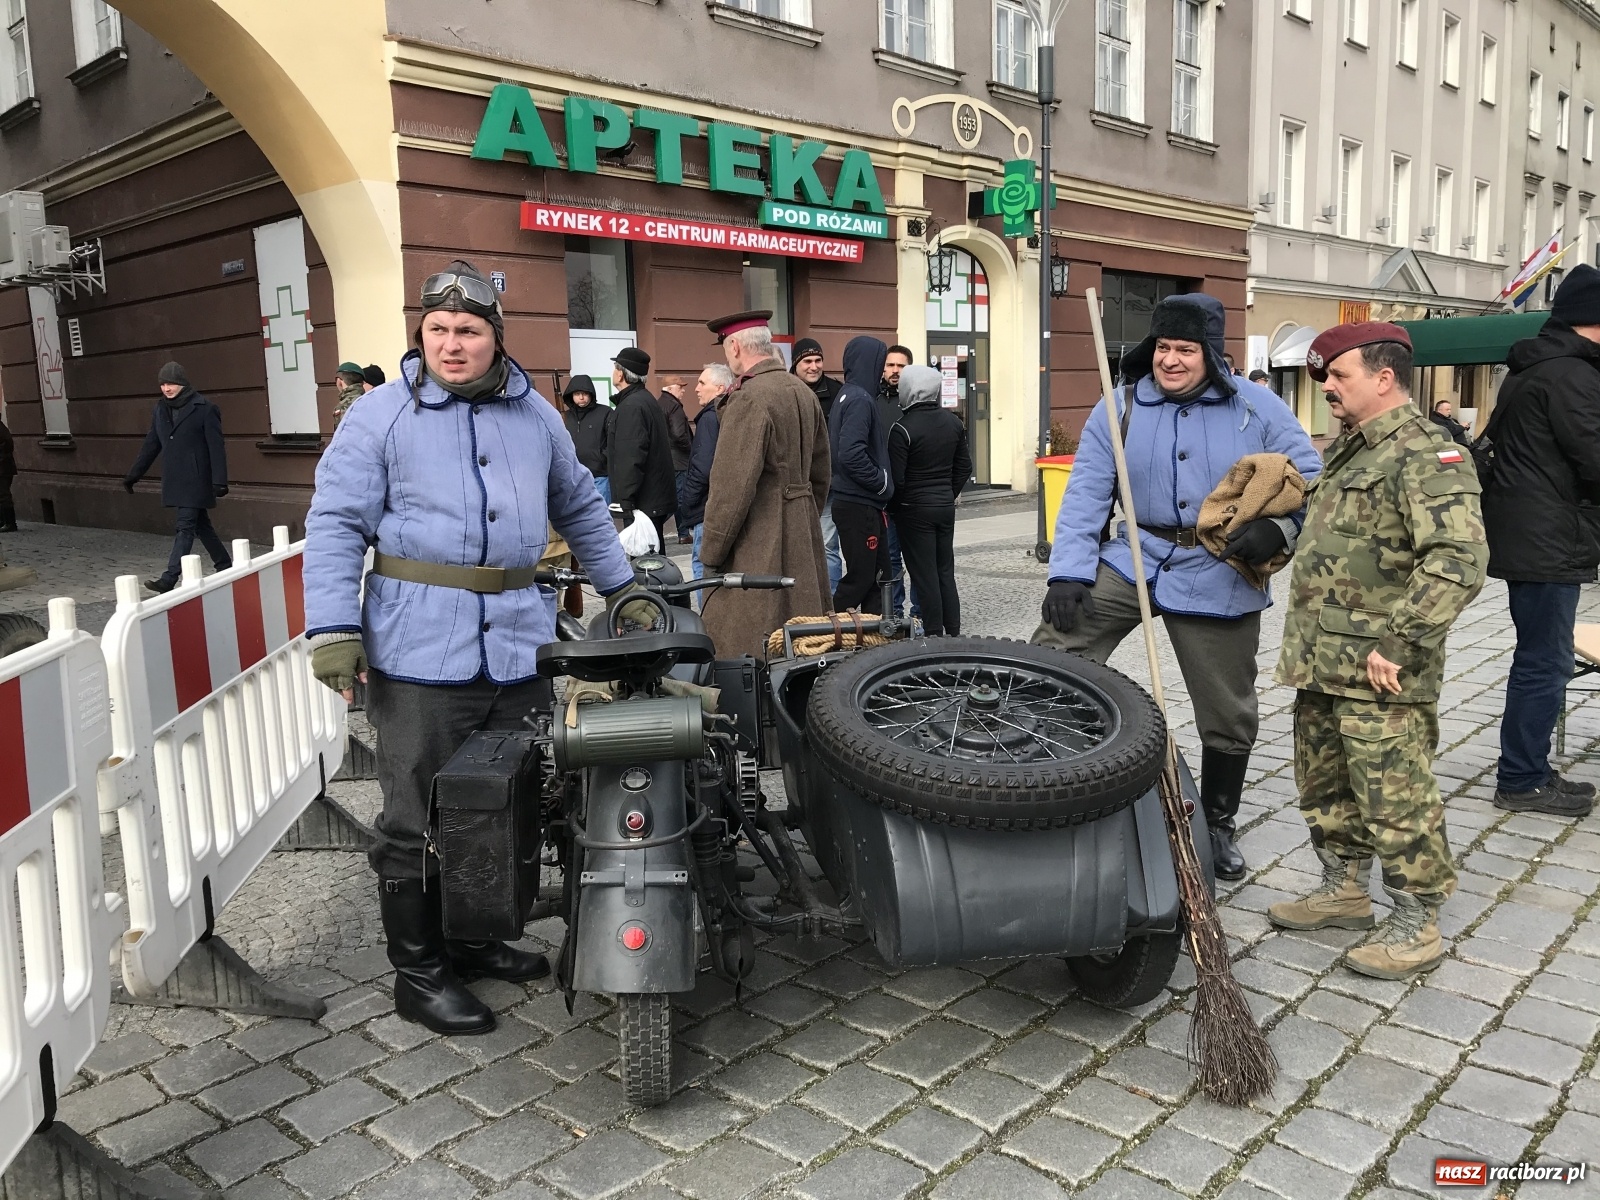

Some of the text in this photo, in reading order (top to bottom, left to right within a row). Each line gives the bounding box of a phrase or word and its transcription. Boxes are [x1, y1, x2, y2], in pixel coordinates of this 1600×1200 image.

[959, 115, 976, 131] 1953
[470, 83, 886, 214] APTEKA
[536, 208, 603, 232] RYNEK
[608, 217, 630, 234] 12
[644, 221, 725, 244] CENTRUM
[729, 231, 858, 258] FARMACEUTYCZNE
[772, 207, 882, 235] POD RÓŻAMI
[493, 278, 503, 288] 12
